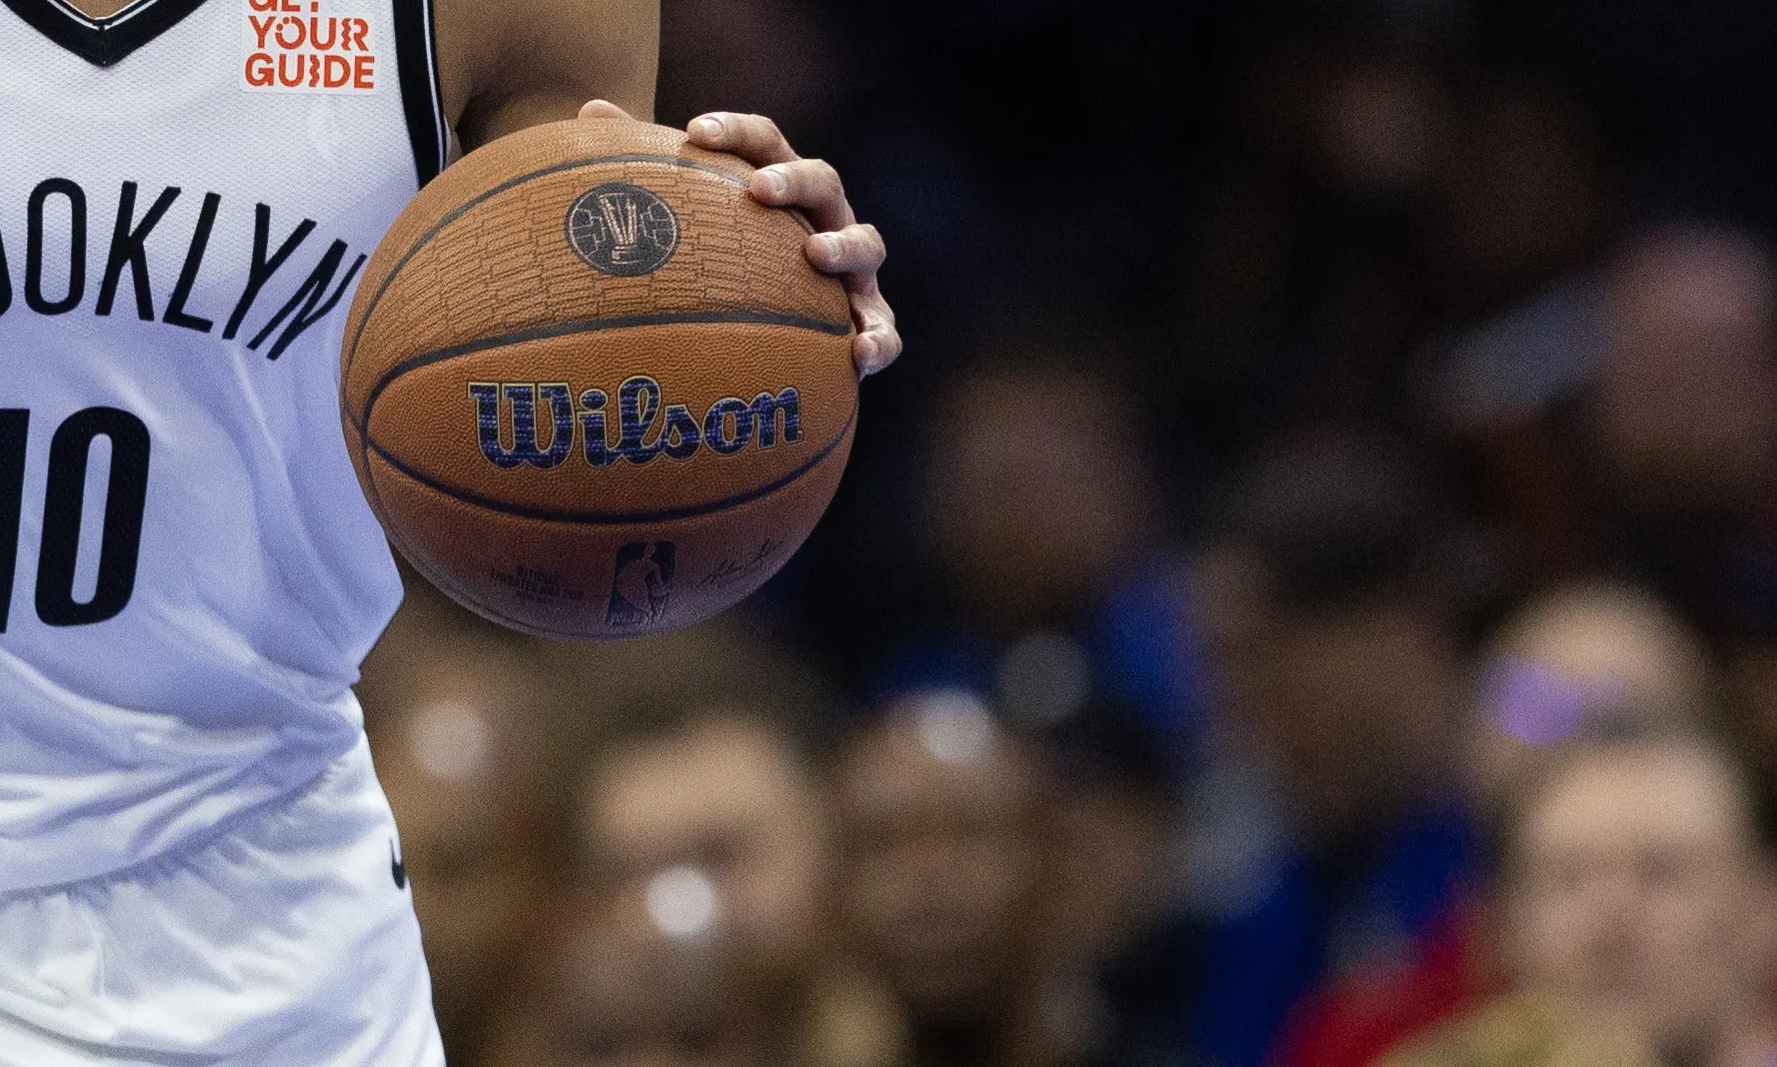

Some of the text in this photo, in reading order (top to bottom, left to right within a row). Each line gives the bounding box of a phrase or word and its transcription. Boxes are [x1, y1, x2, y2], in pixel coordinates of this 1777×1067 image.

[248, 15, 369, 51] YOUR
[244, 52, 375, 89] GUIDE
[468, 376, 802, 470] Wilson
